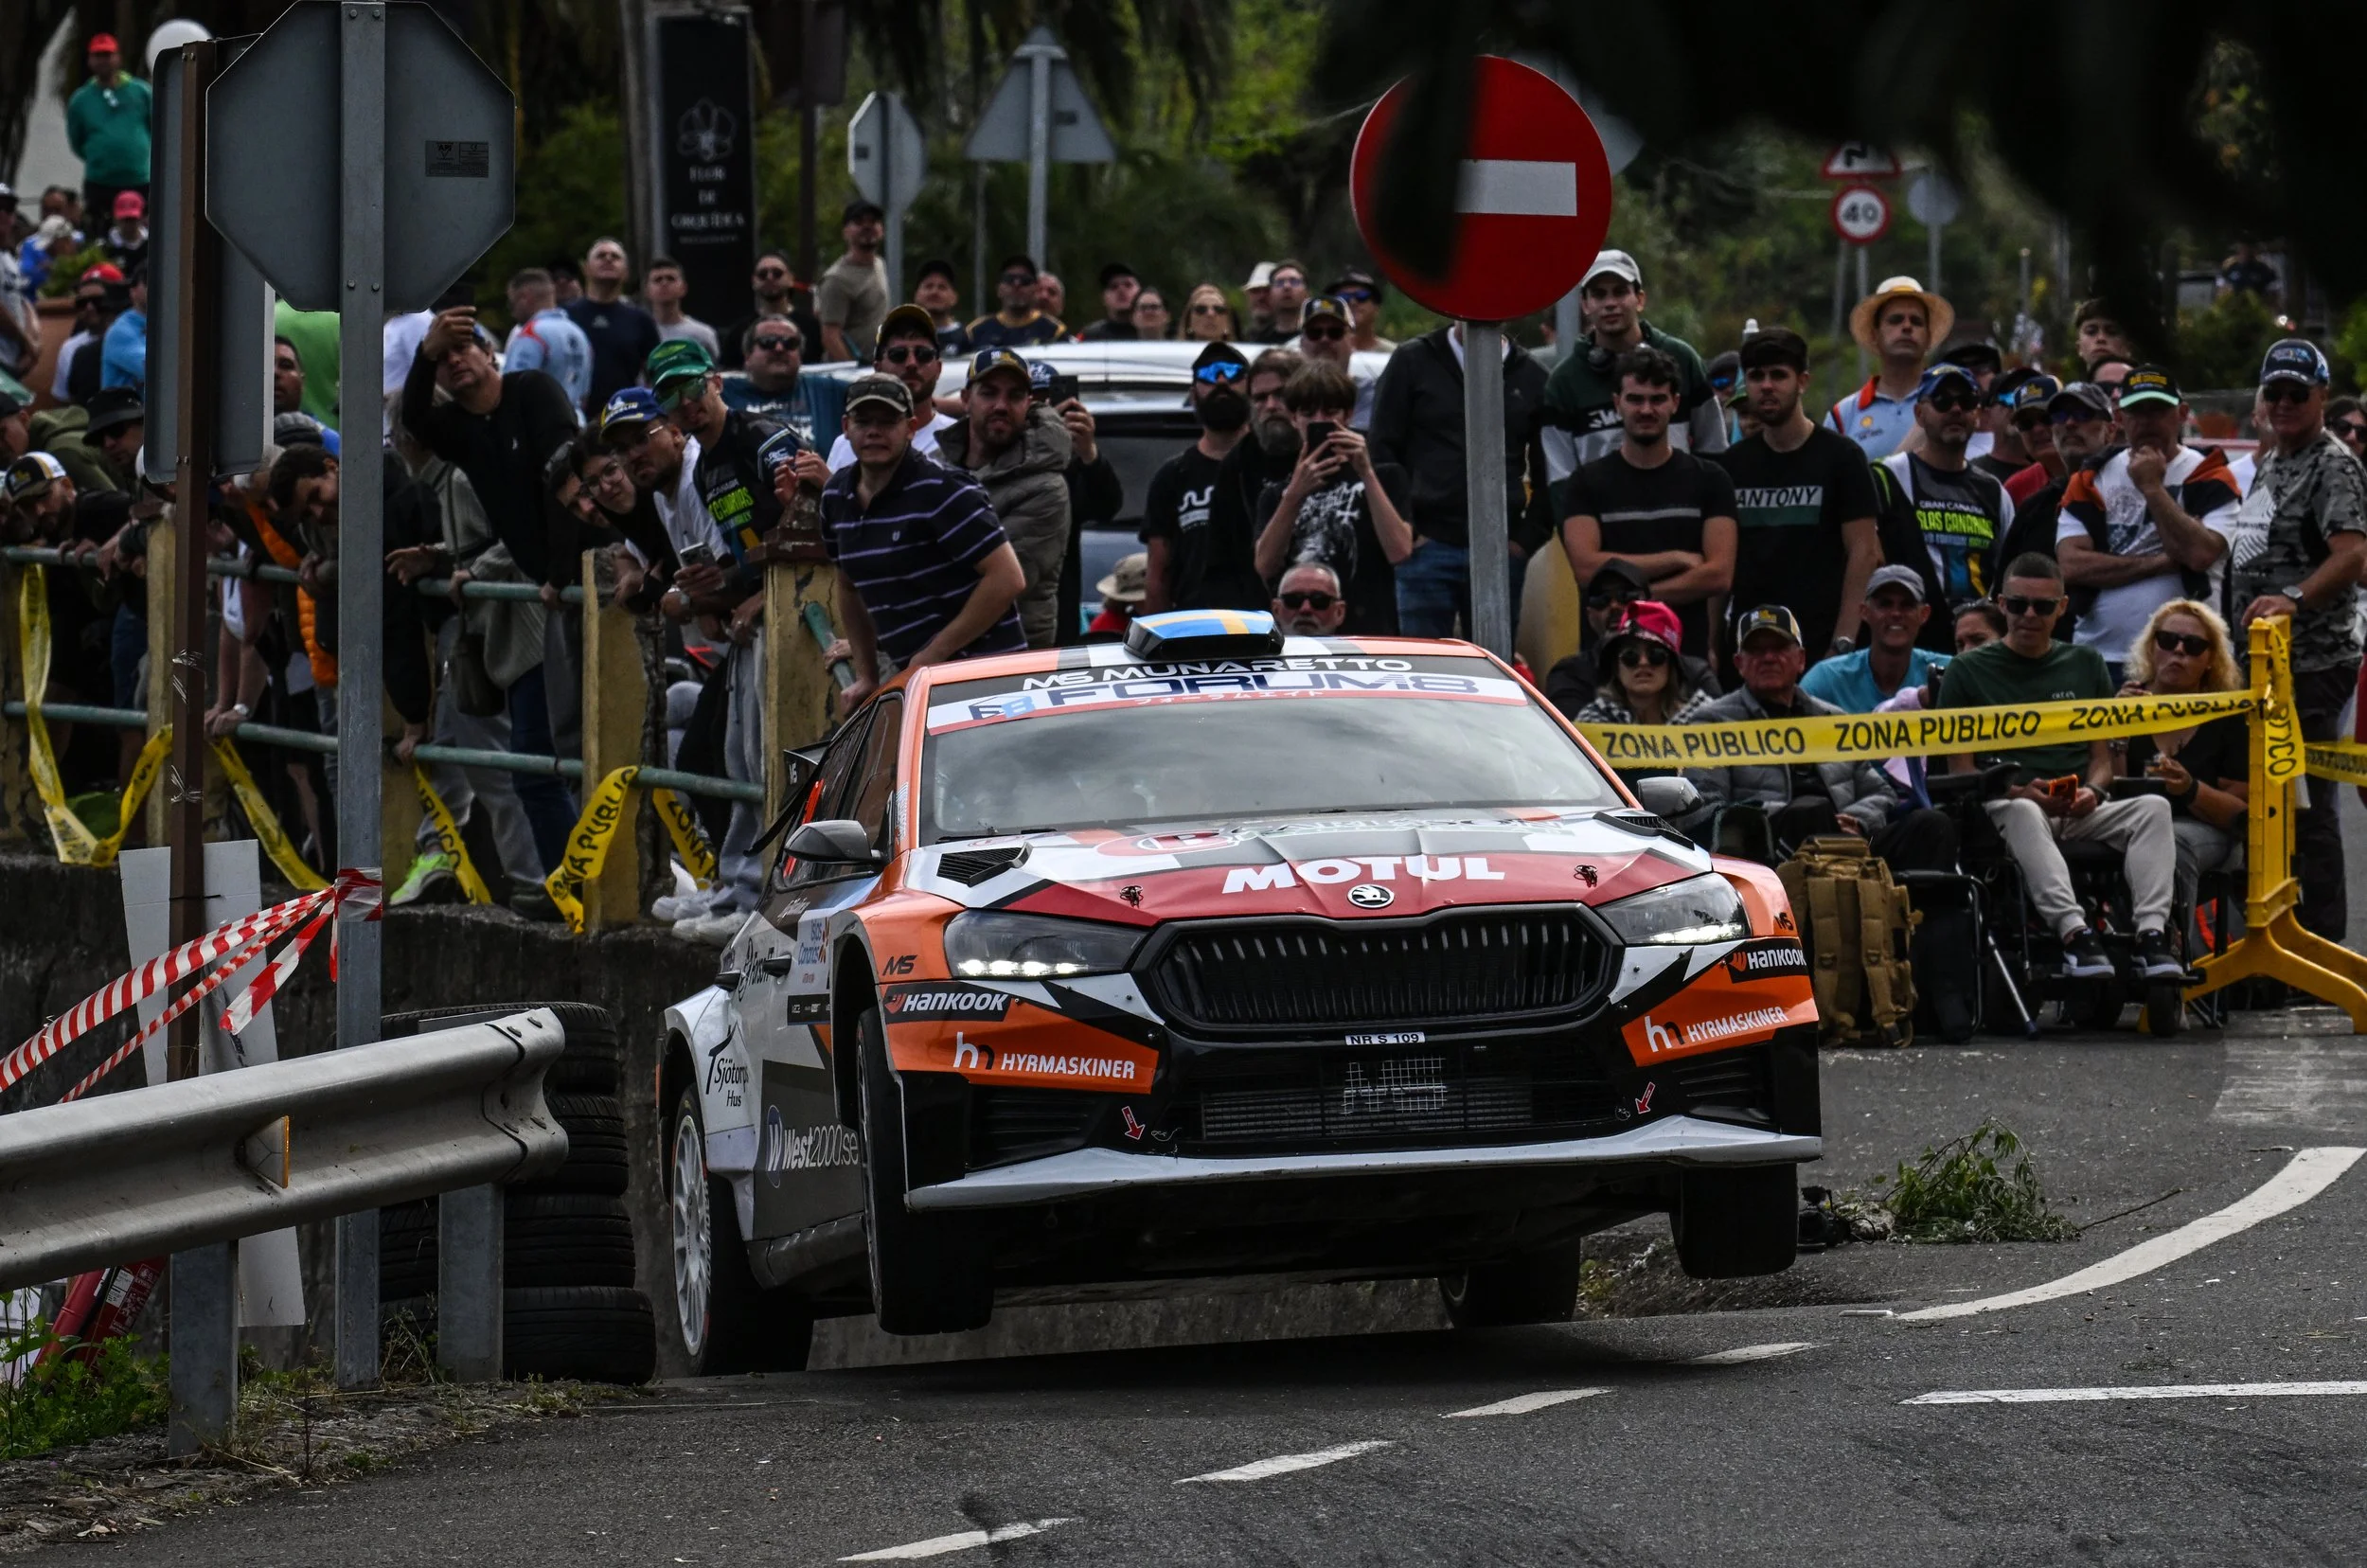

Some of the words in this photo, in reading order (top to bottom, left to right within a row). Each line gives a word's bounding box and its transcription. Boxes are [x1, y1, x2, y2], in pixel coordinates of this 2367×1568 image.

[1842, 203, 1878, 223] 40
[1736, 487, 1819, 508] ANTONY
[1023, 670, 1094, 690] MS
[1102, 659, 1413, 681] MUNARETTO
[1047, 673, 1480, 706] FORUM8
[1834, 720, 1913, 752] ZONA
[1920, 710, 2041, 746] PUBLICO
[2068, 704, 2145, 731] ZONA
[1602, 732, 1682, 758] ZONA
[1683, 727, 1806, 758] PUBLICO
[578, 768, 634, 850] PUBLIC
[1221, 854, 1505, 894] MOTUL
[882, 954, 917, 976] MS
[1350, 1034, 1372, 1044] NR
[1378, 1034, 1388, 1043] S
[1394, 1033, 1419, 1042] 109
[1686, 1006, 1789, 1042] HYRMASKINER
[1001, 1053, 1135, 1079] HYRMASKINER
[726, 1090, 741, 1107] Hus
[782, 1124, 859, 1170] West2000.se
